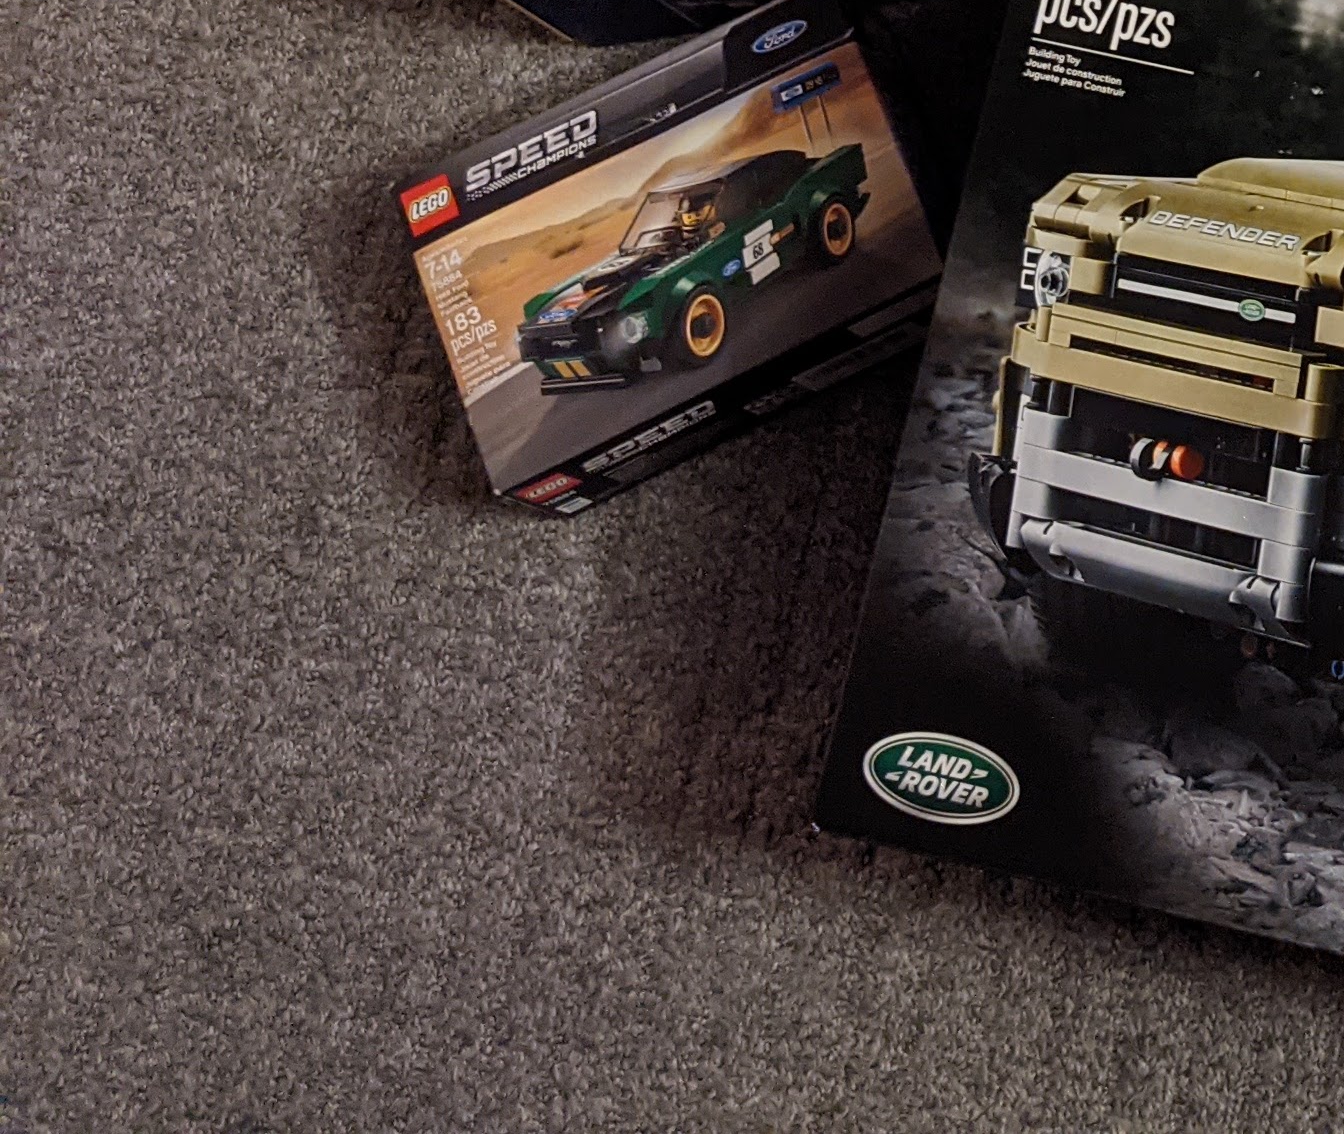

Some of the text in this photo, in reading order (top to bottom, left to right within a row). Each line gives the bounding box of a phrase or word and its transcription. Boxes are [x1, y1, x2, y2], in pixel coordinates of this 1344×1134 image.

[1025, 58, 1123, 86] Jouet de construction
[1028, 46, 1082, 67] Building Toy
[1022, 68, 1126, 97] Juguete para Construir
[465, 110, 598, 193] SPEED
[410, 187, 451, 222] LEGO
[1149, 210, 1301, 251] DEFENDER
[424, 248, 463, 280] 7-14
[752, 242, 764, 260] 68
[445, 306, 482, 336] 183
[451, 319, 497, 356] pcs/pzs
[896, 745, 974, 781] LAND
[898, 770, 990, 809] ROVER
